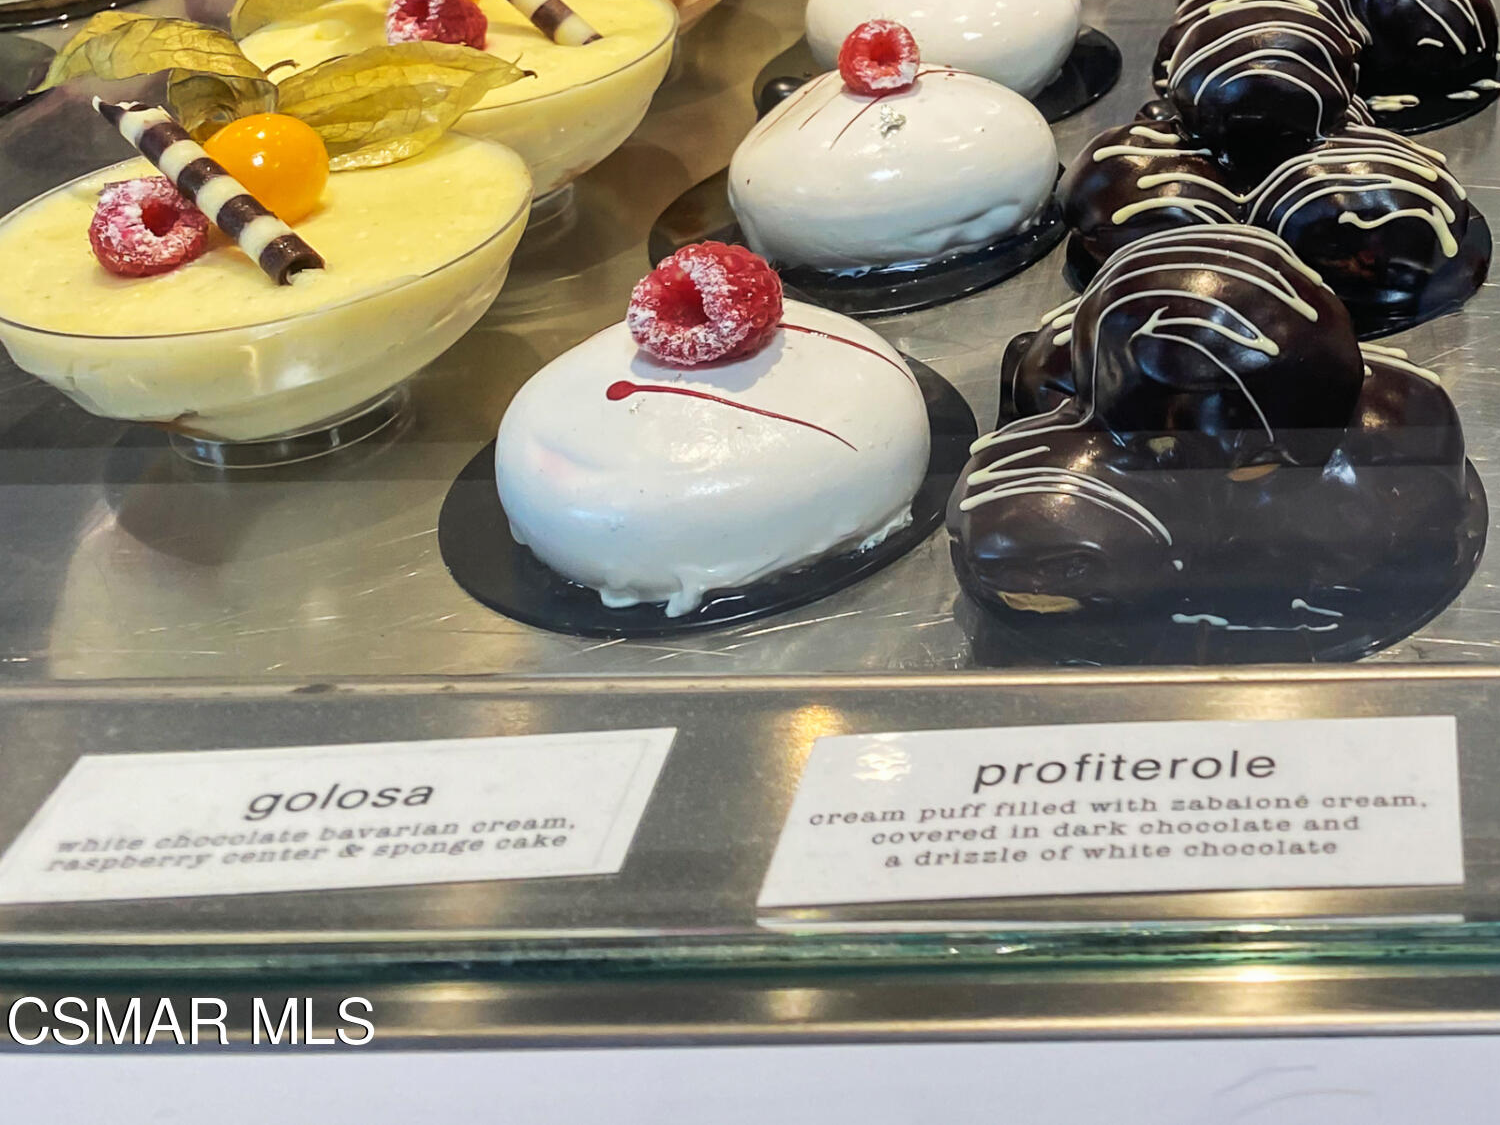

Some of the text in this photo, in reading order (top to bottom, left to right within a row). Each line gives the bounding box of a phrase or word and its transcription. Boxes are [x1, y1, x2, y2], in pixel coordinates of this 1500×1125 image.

[973, 749, 1276, 794] profiterole
[244, 783, 435, 822] golosa
[809, 807, 905, 826] cream
[917, 802, 986, 824] puff
[994, 799, 1079, 817] filled
[1091, 797, 1157, 813] with
[1322, 791, 1428, 809] cream,
[56, 817, 576, 854] white chocolate bavarian cream,
[871, 815, 1360, 845] covered in dark chocolate and
[47, 832, 568, 873] raspberry center & sponge cake
[885, 838, 1338, 868] a drizzle of white chocolate
